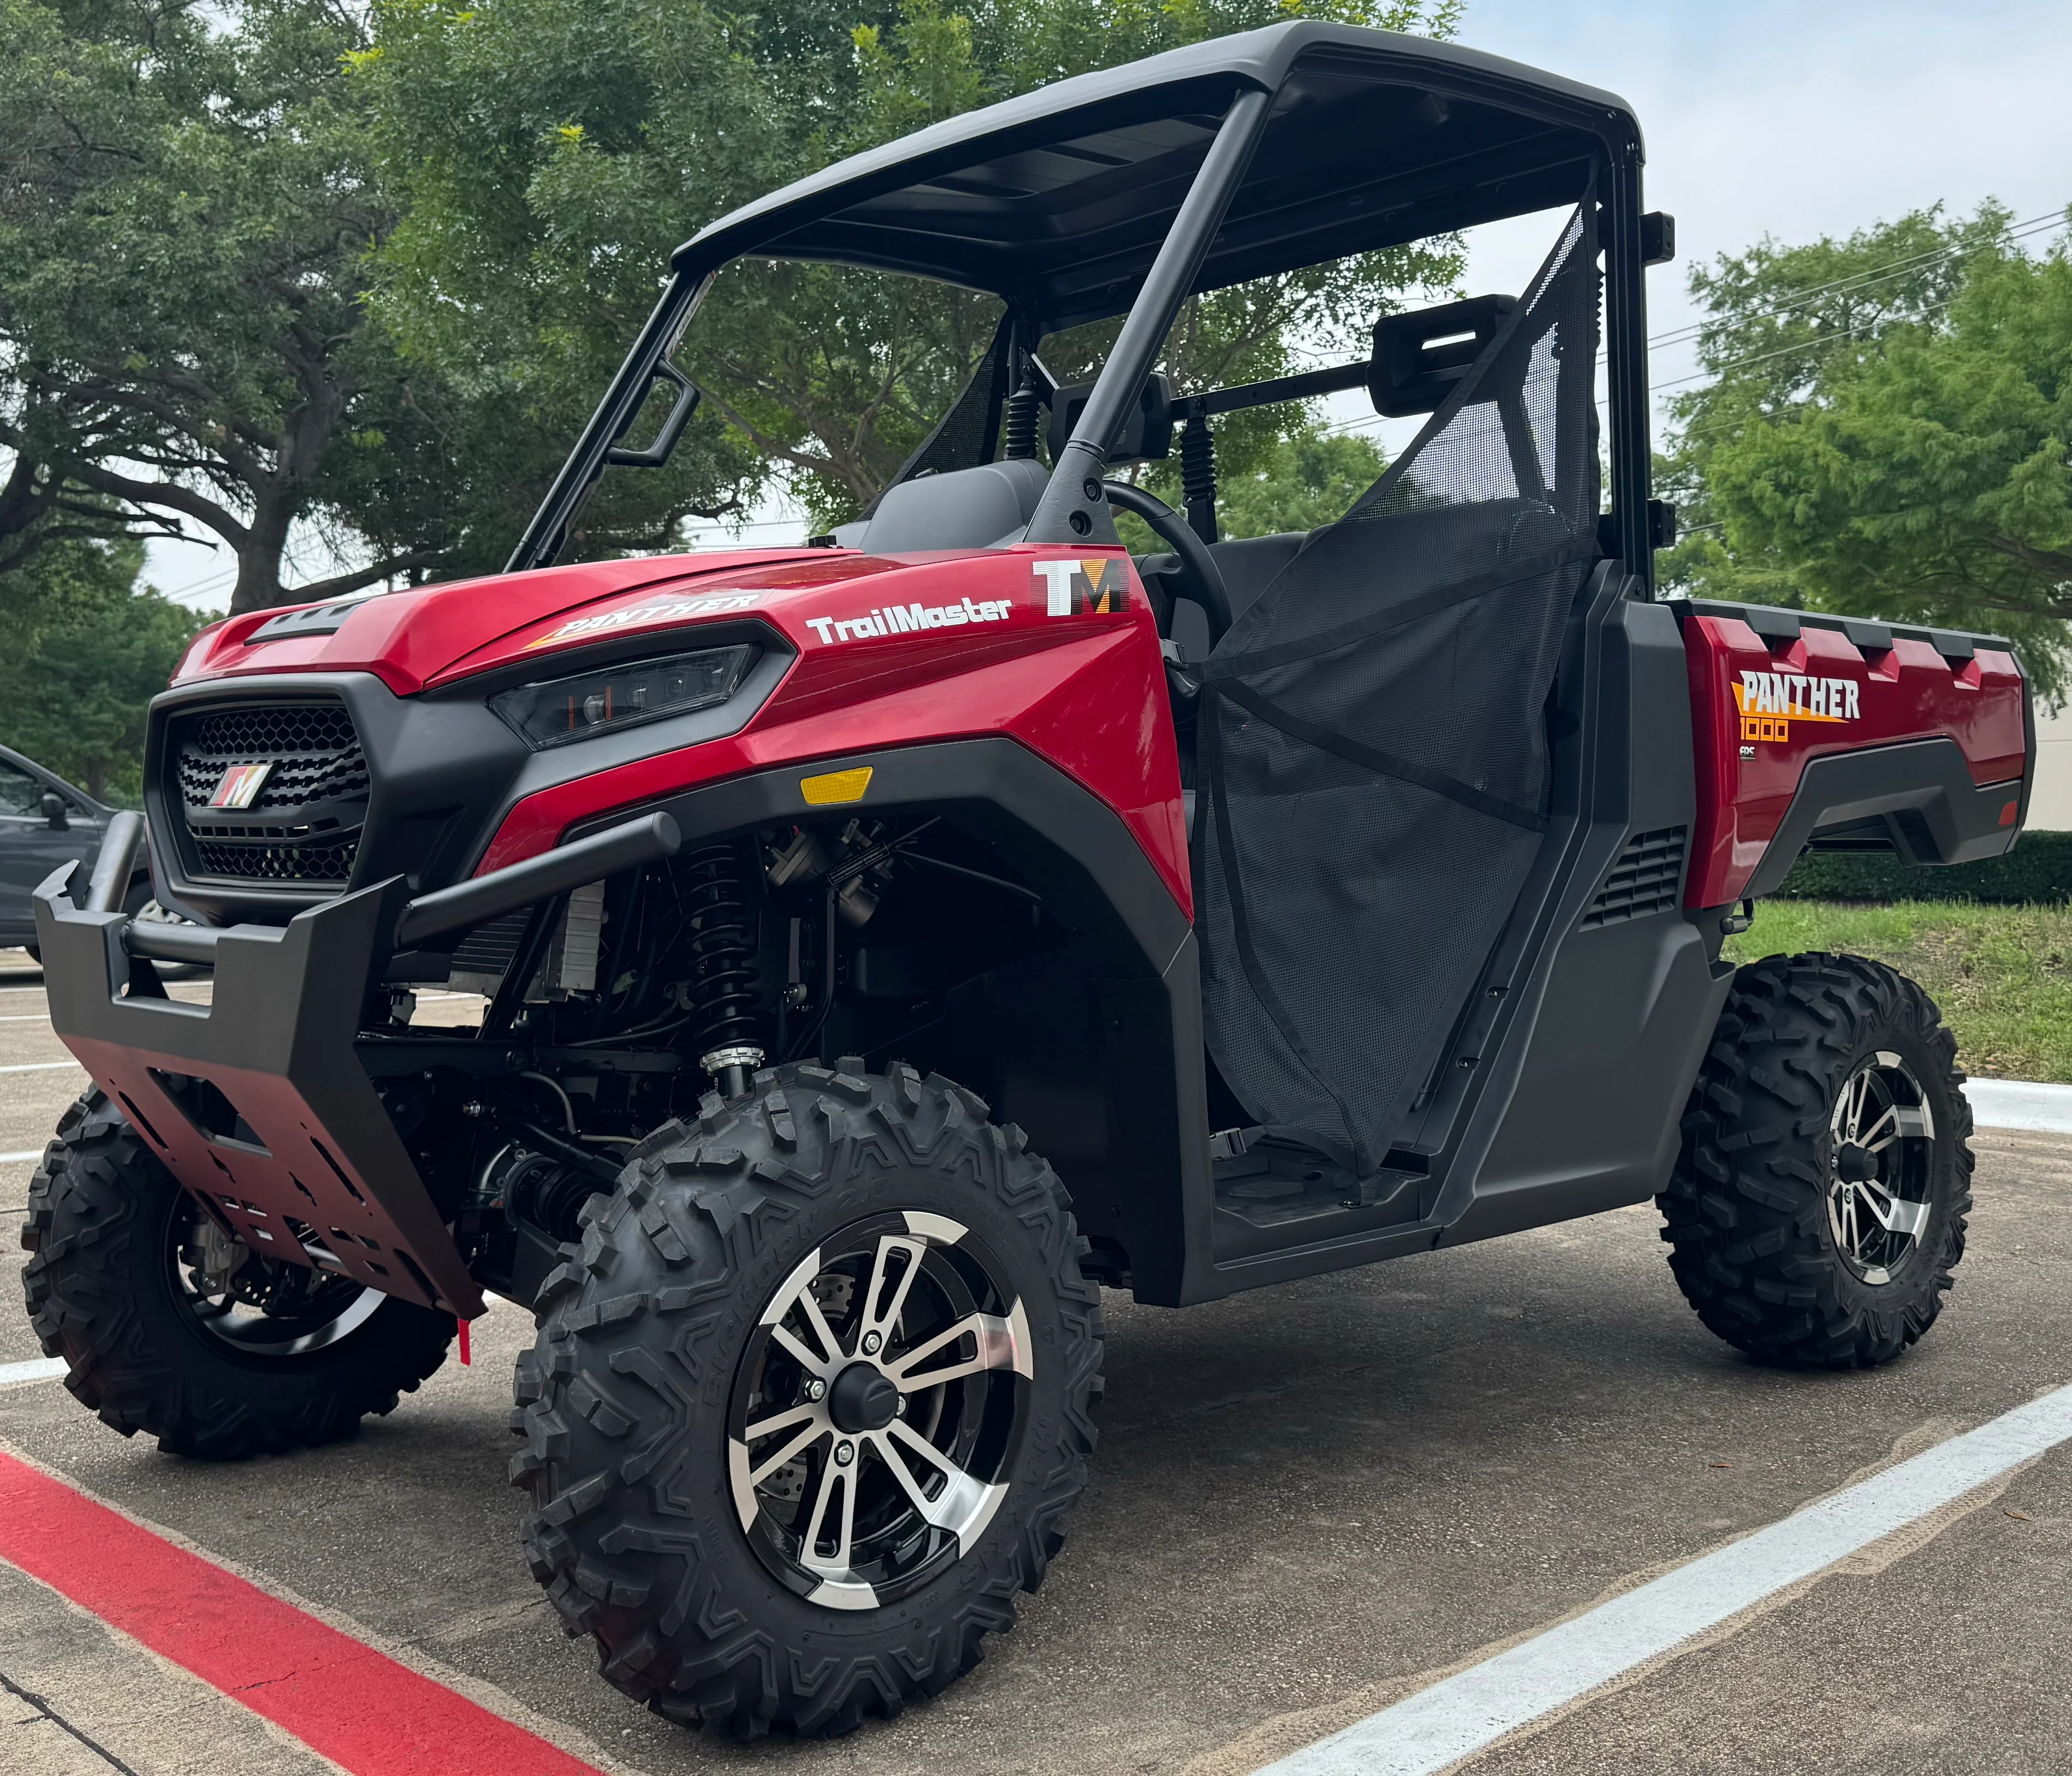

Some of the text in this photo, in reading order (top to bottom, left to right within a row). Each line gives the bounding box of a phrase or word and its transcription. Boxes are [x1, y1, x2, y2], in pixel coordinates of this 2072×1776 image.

[1031, 559, 1126, 617] TM
[553, 594, 759, 637] PANTHER
[805, 596, 1013, 645] TrailMaster
[1739, 670, 1861, 719] PANTHER
[1739, 717, 1789, 743] 1000
